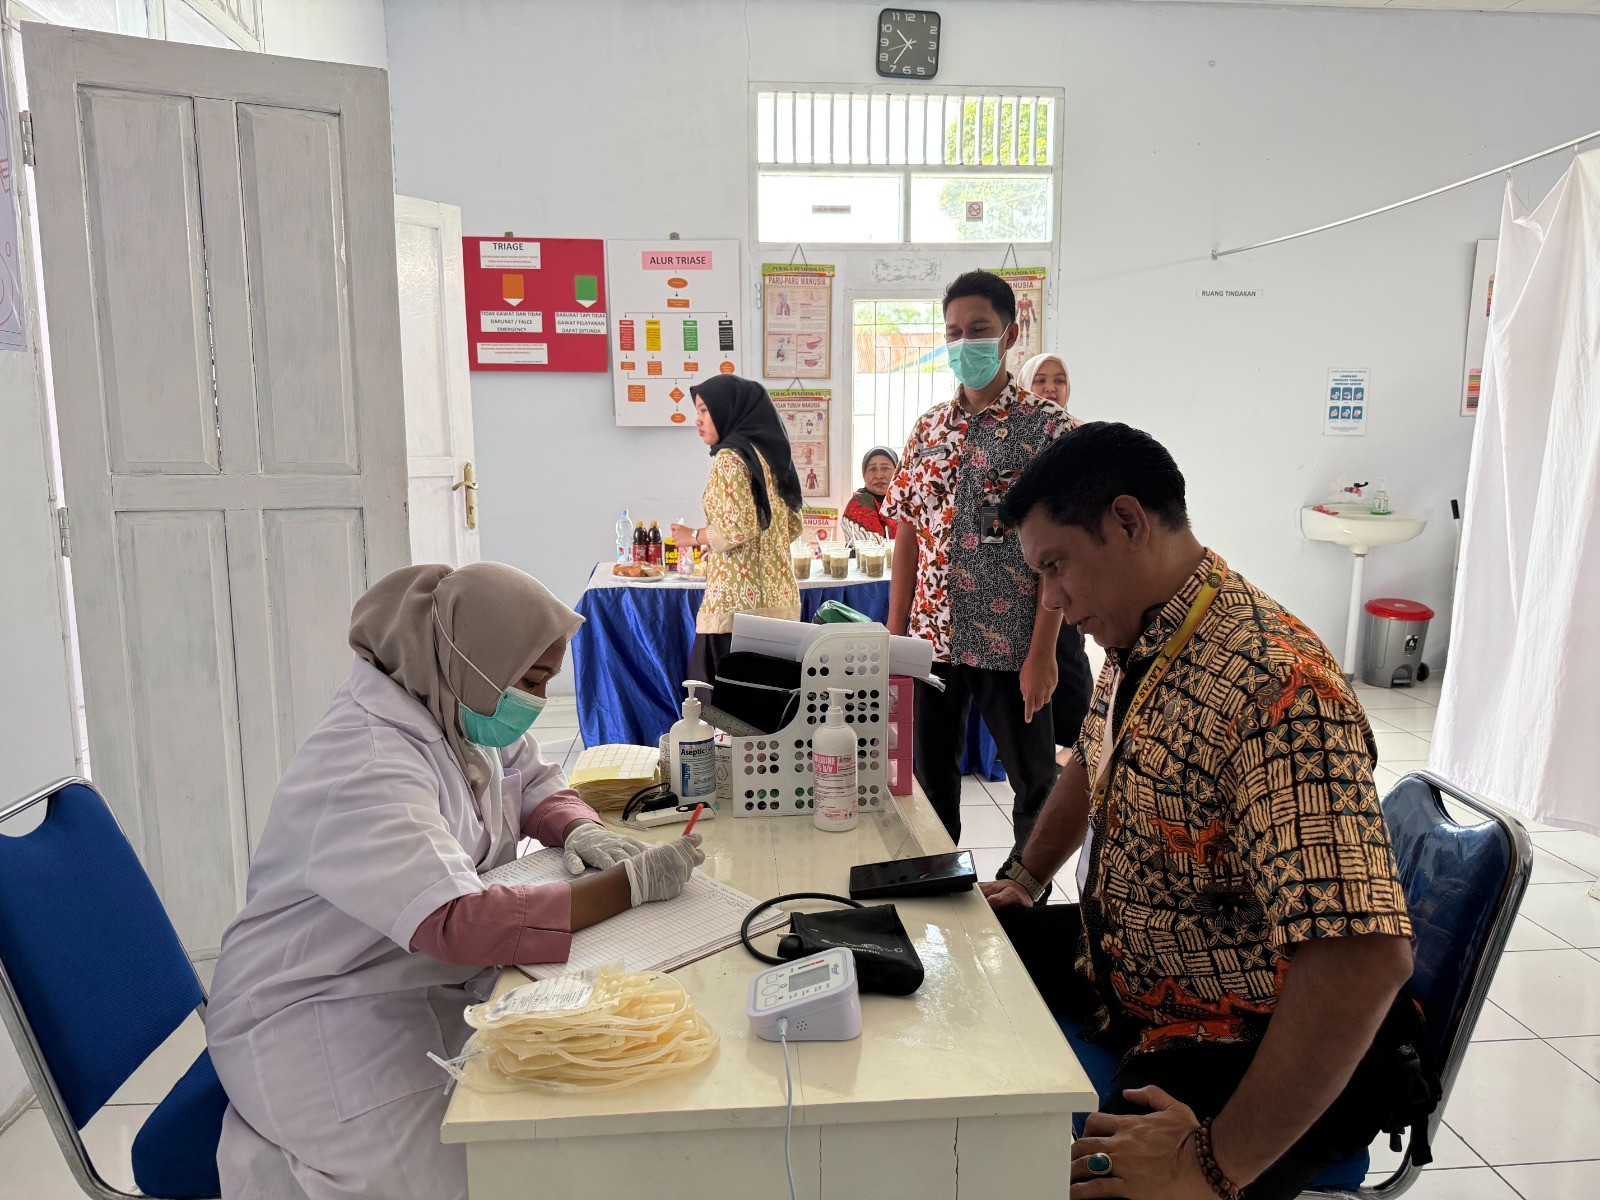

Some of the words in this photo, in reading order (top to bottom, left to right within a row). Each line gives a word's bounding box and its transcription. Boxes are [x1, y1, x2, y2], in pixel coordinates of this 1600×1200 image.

[892, 12, 900, 21] 11
[905, 13, 916, 22] 12
[922, 14, 927, 23] 1
[881, 24, 893, 33] 10
[929, 26, 938, 35] 2
[880, 38, 889, 47] 9
[928, 41, 937, 50] 3
[879, 52, 889, 62] 8
[927, 56, 936, 66] 4
[889, 64, 897, 73] 7
[902, 65, 912, 75] 6
[916, 66, 926, 75] 5
[492, 242, 524, 251] TRIAGE
[649, 256, 674, 265] ALUR
[676, 256, 706, 265] TRIASE
[768, 277, 798, 285] PARU-PARU
[800, 278, 826, 286] MANUSIA
[1139, 664, 1163, 698] LAPAS
